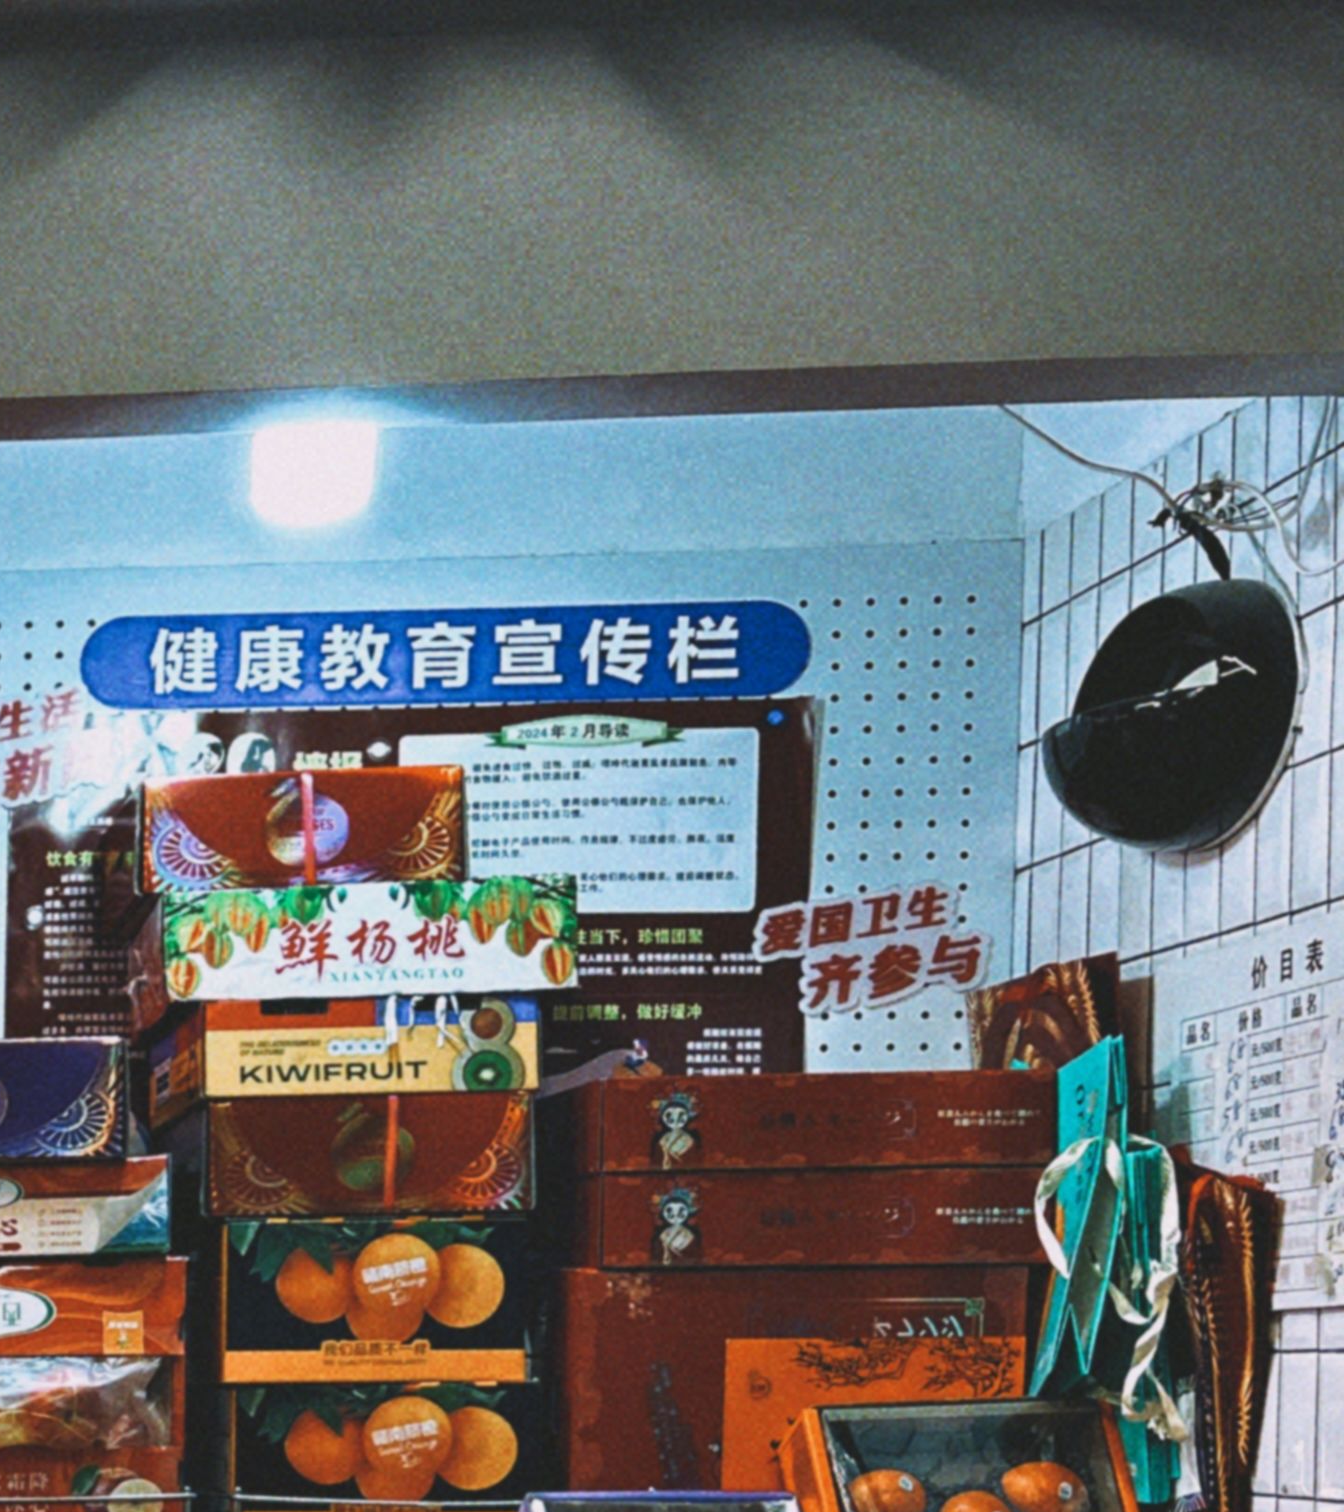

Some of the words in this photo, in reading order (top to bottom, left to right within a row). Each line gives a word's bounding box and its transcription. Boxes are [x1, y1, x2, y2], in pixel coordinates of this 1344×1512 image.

[150, 615, 741, 695] 健康教育宣传栏
[275, 917, 467, 985] 鲜杨桃
[760, 888, 950, 955] 爱国卫生
[329, 966, 465, 983] XIANYANGTAO
[809, 933, 983, 1008] 齐参与
[1250, 938, 1325, 991] 价目表
[238, 1060, 428, 1085] KIWIFRUIT
